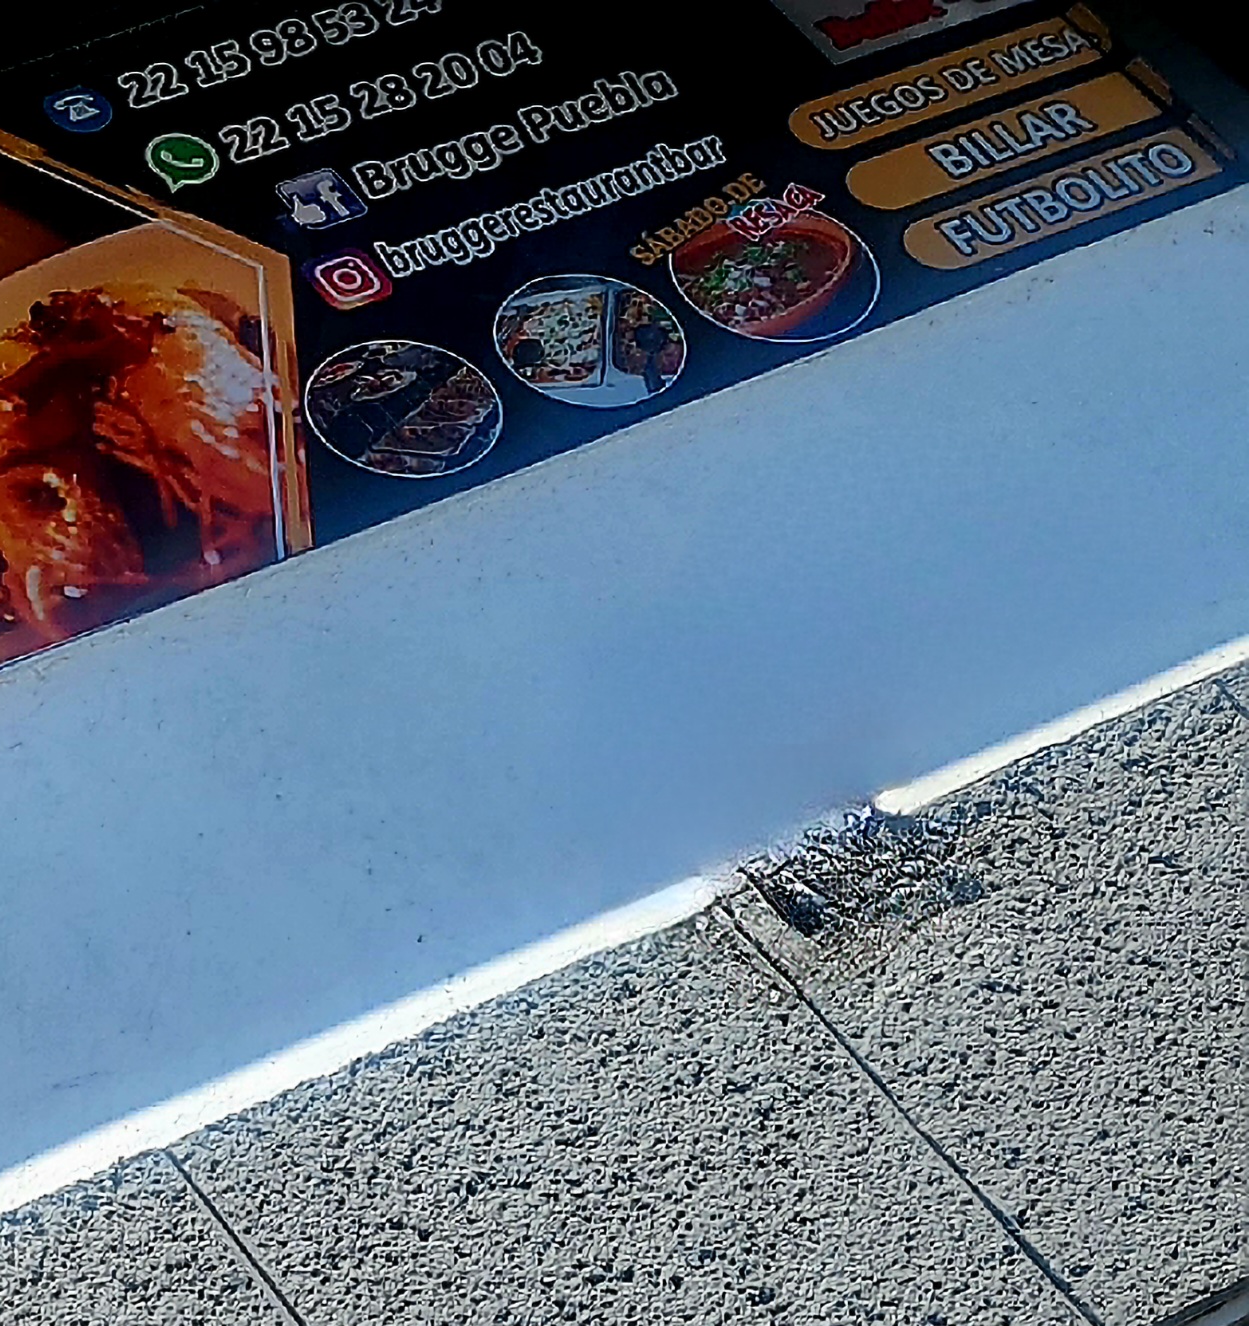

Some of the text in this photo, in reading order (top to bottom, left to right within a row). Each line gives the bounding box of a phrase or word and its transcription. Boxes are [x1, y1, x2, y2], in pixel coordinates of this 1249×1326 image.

[119, 62, 189, 109] 22
[184, 39, 252, 89] 15
[250, 18, 316, 66] 98
[313, 0, 380, 46] 53
[219, 31, 543, 165] 22 15 28 20 04
[810, 26, 1090, 139] JUEGOS DE MESA
[352, 119, 525, 200] Brugge
[518, 70, 678, 143] Puebla
[928, 103, 1094, 178] BILLAR
[374, 135, 727, 279] bruggerestaurantbar
[936, 142, 1193, 256] FUTBOLITO
